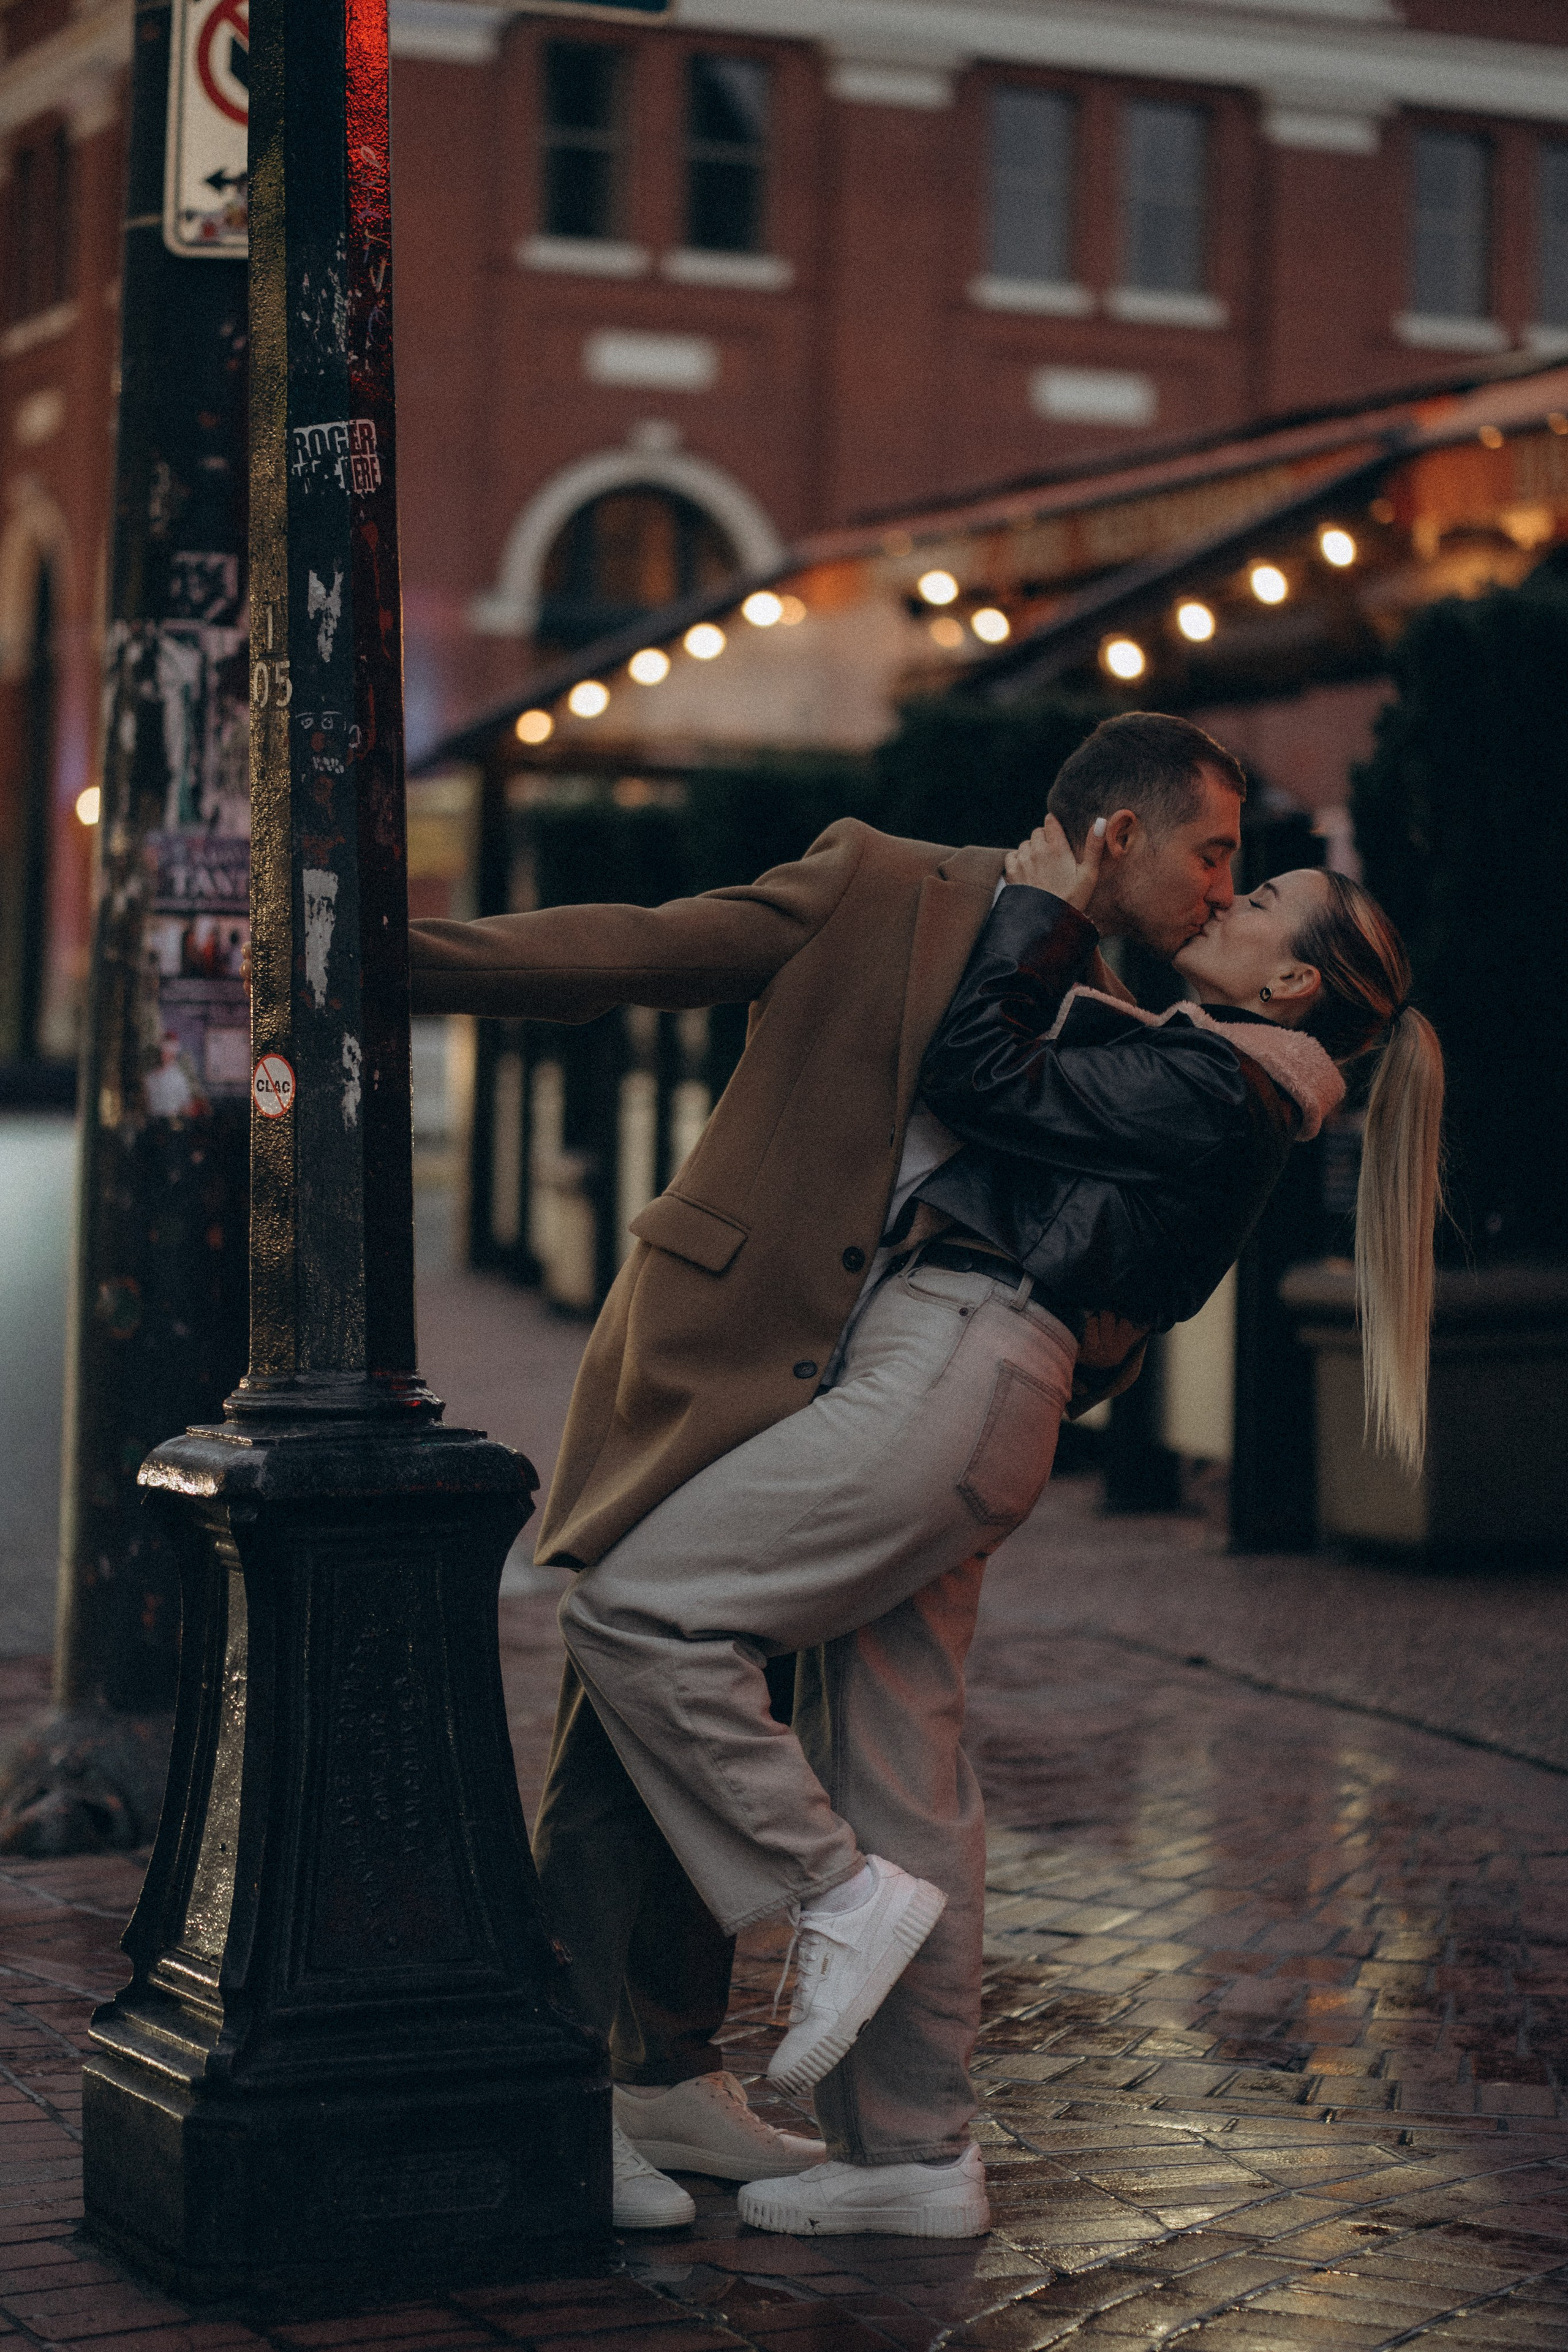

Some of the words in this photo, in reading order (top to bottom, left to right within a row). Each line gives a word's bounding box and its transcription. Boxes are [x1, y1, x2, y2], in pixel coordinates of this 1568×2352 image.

[292, 423, 375, 464] ROGER
[252, 660, 293, 709] 05
[256, 1079, 290, 1093] CLAC
